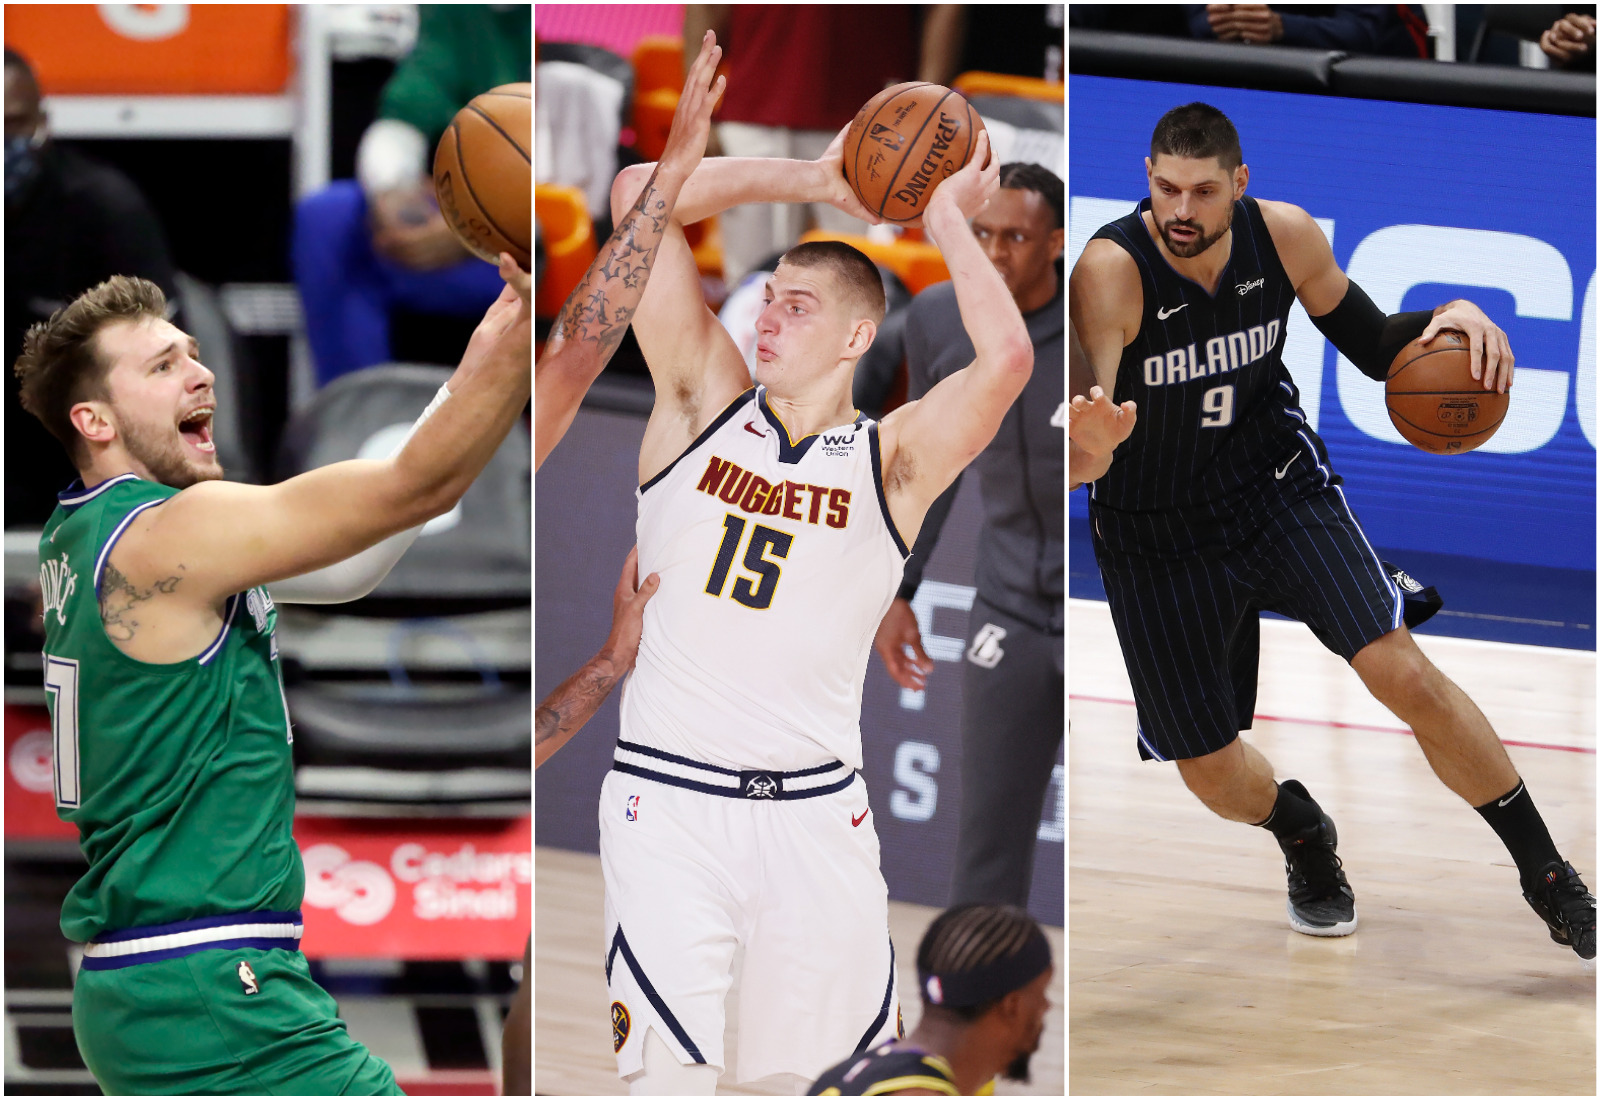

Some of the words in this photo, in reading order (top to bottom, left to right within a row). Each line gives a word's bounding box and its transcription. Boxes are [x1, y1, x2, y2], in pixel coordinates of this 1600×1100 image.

[892, 111, 961, 208] SPALDING
[1143, 318, 1281, 387] ORLANDO
[823, 434, 855, 446] WU
[1200, 384, 1236, 428] 9
[696, 455, 852, 530] NUGGETS
[703, 512, 796, 611] 15
